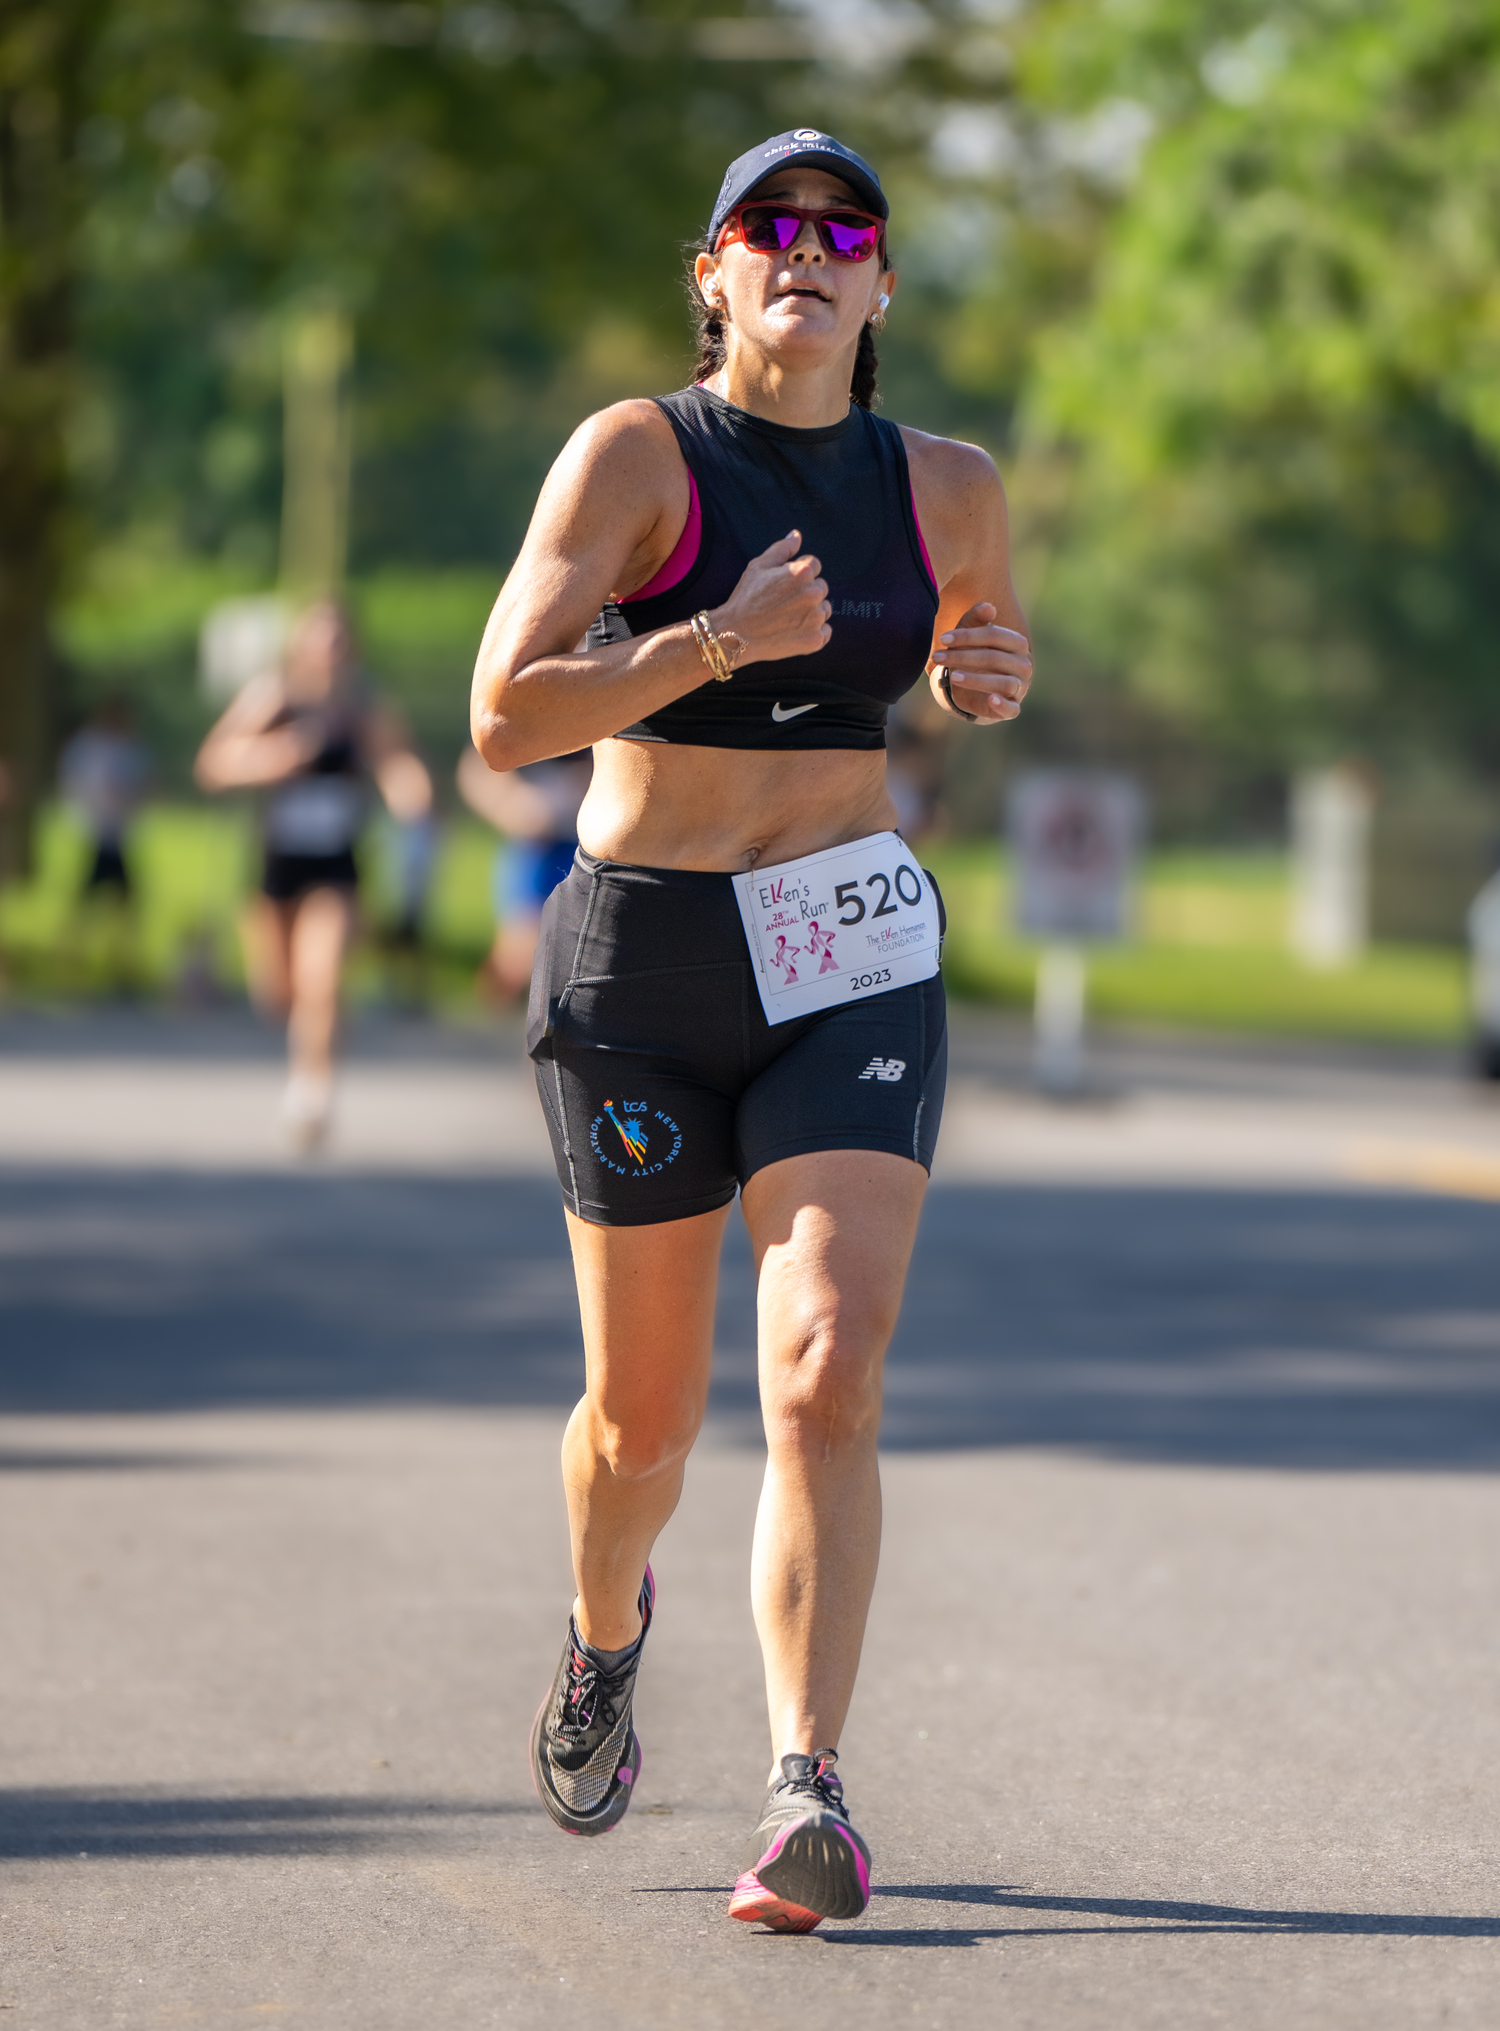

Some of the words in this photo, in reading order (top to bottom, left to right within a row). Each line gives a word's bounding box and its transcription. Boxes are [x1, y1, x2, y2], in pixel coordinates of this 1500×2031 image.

[764, 142, 799, 158] chick
[834, 865, 922, 926] 520
[765, 916, 799, 932] ANNUAL
[865, 935, 880, 946] The
[878, 933, 924, 953] FOUNDATION
[850, 968, 892, 991] 2023
[654, 1110, 679, 1132] NEW
[590, 1116, 626, 1175] MARATHON
[664, 1134, 682, 1163] YORK
[632, 1163, 663, 1176] CITY
